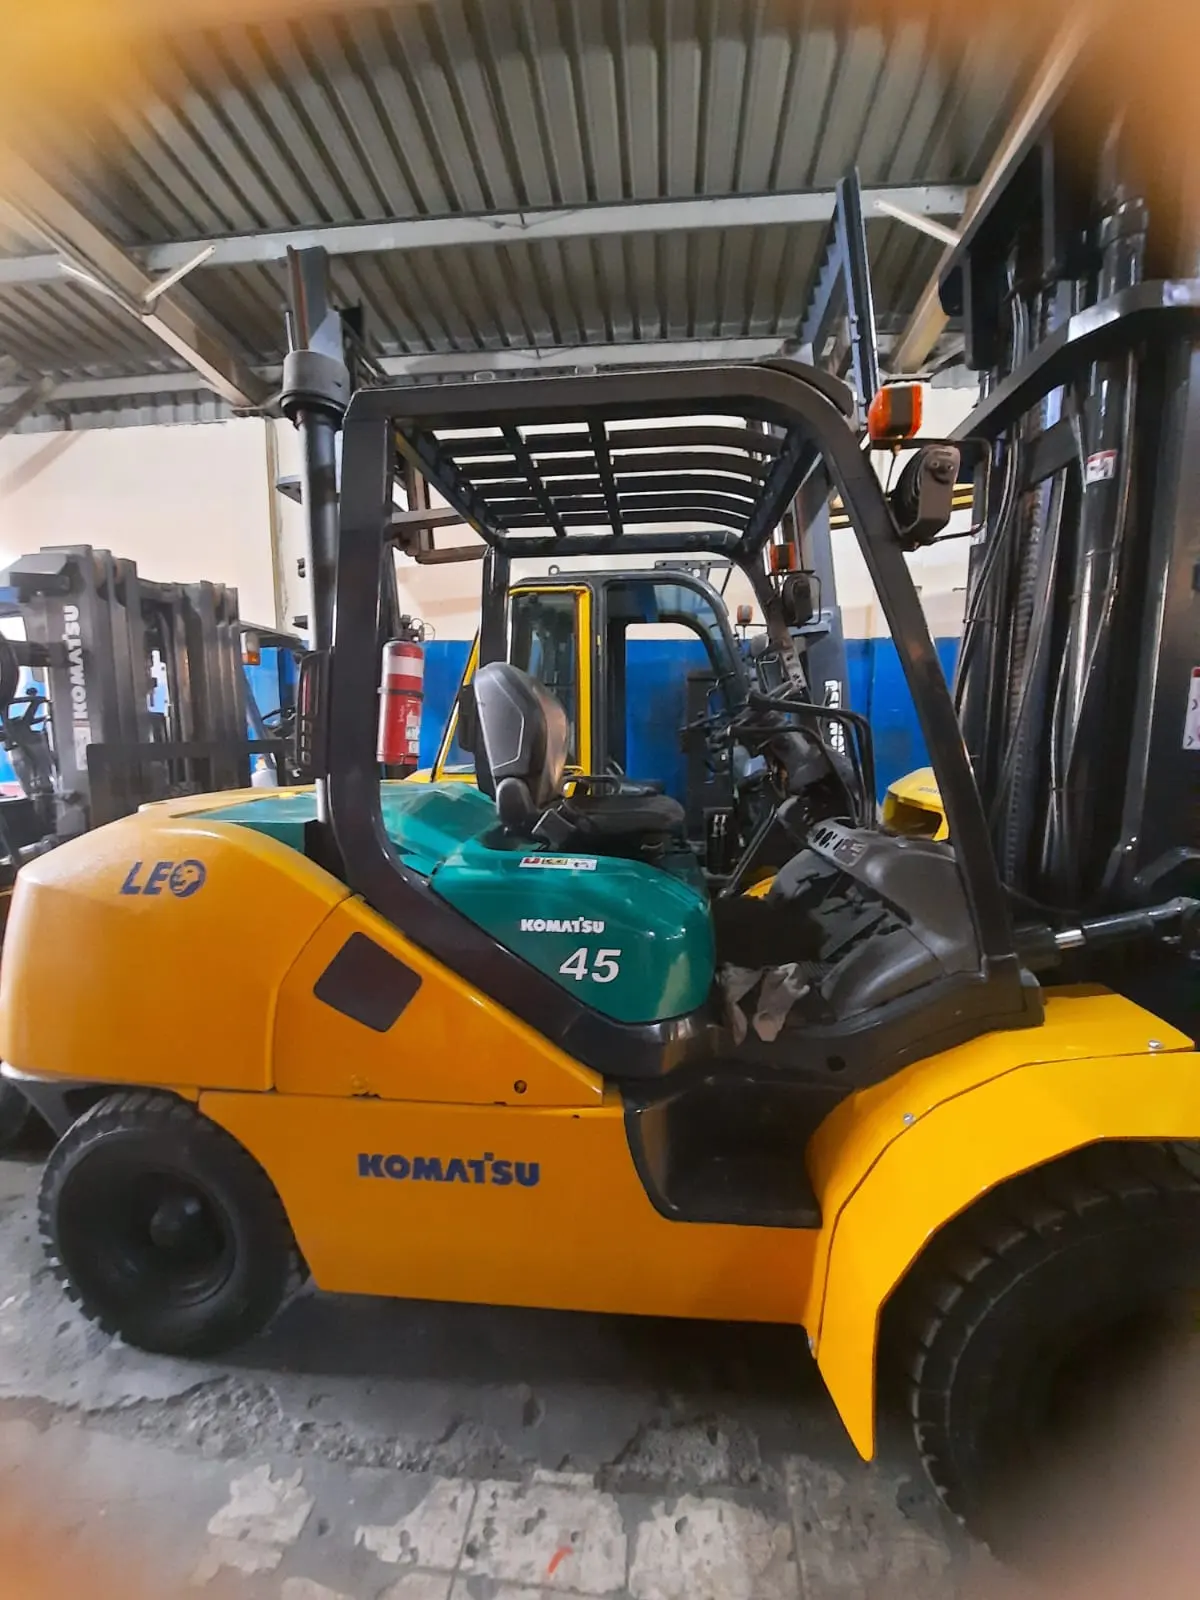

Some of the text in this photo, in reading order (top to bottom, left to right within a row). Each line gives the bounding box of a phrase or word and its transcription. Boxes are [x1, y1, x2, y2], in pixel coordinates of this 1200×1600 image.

[62, 605, 88, 719] KOMATSU
[120, 859, 206, 897] LEO
[520, 916, 605, 933] KOMATSU
[559, 947, 621, 983] 45
[357, 1152, 540, 1187] KOMATSU
